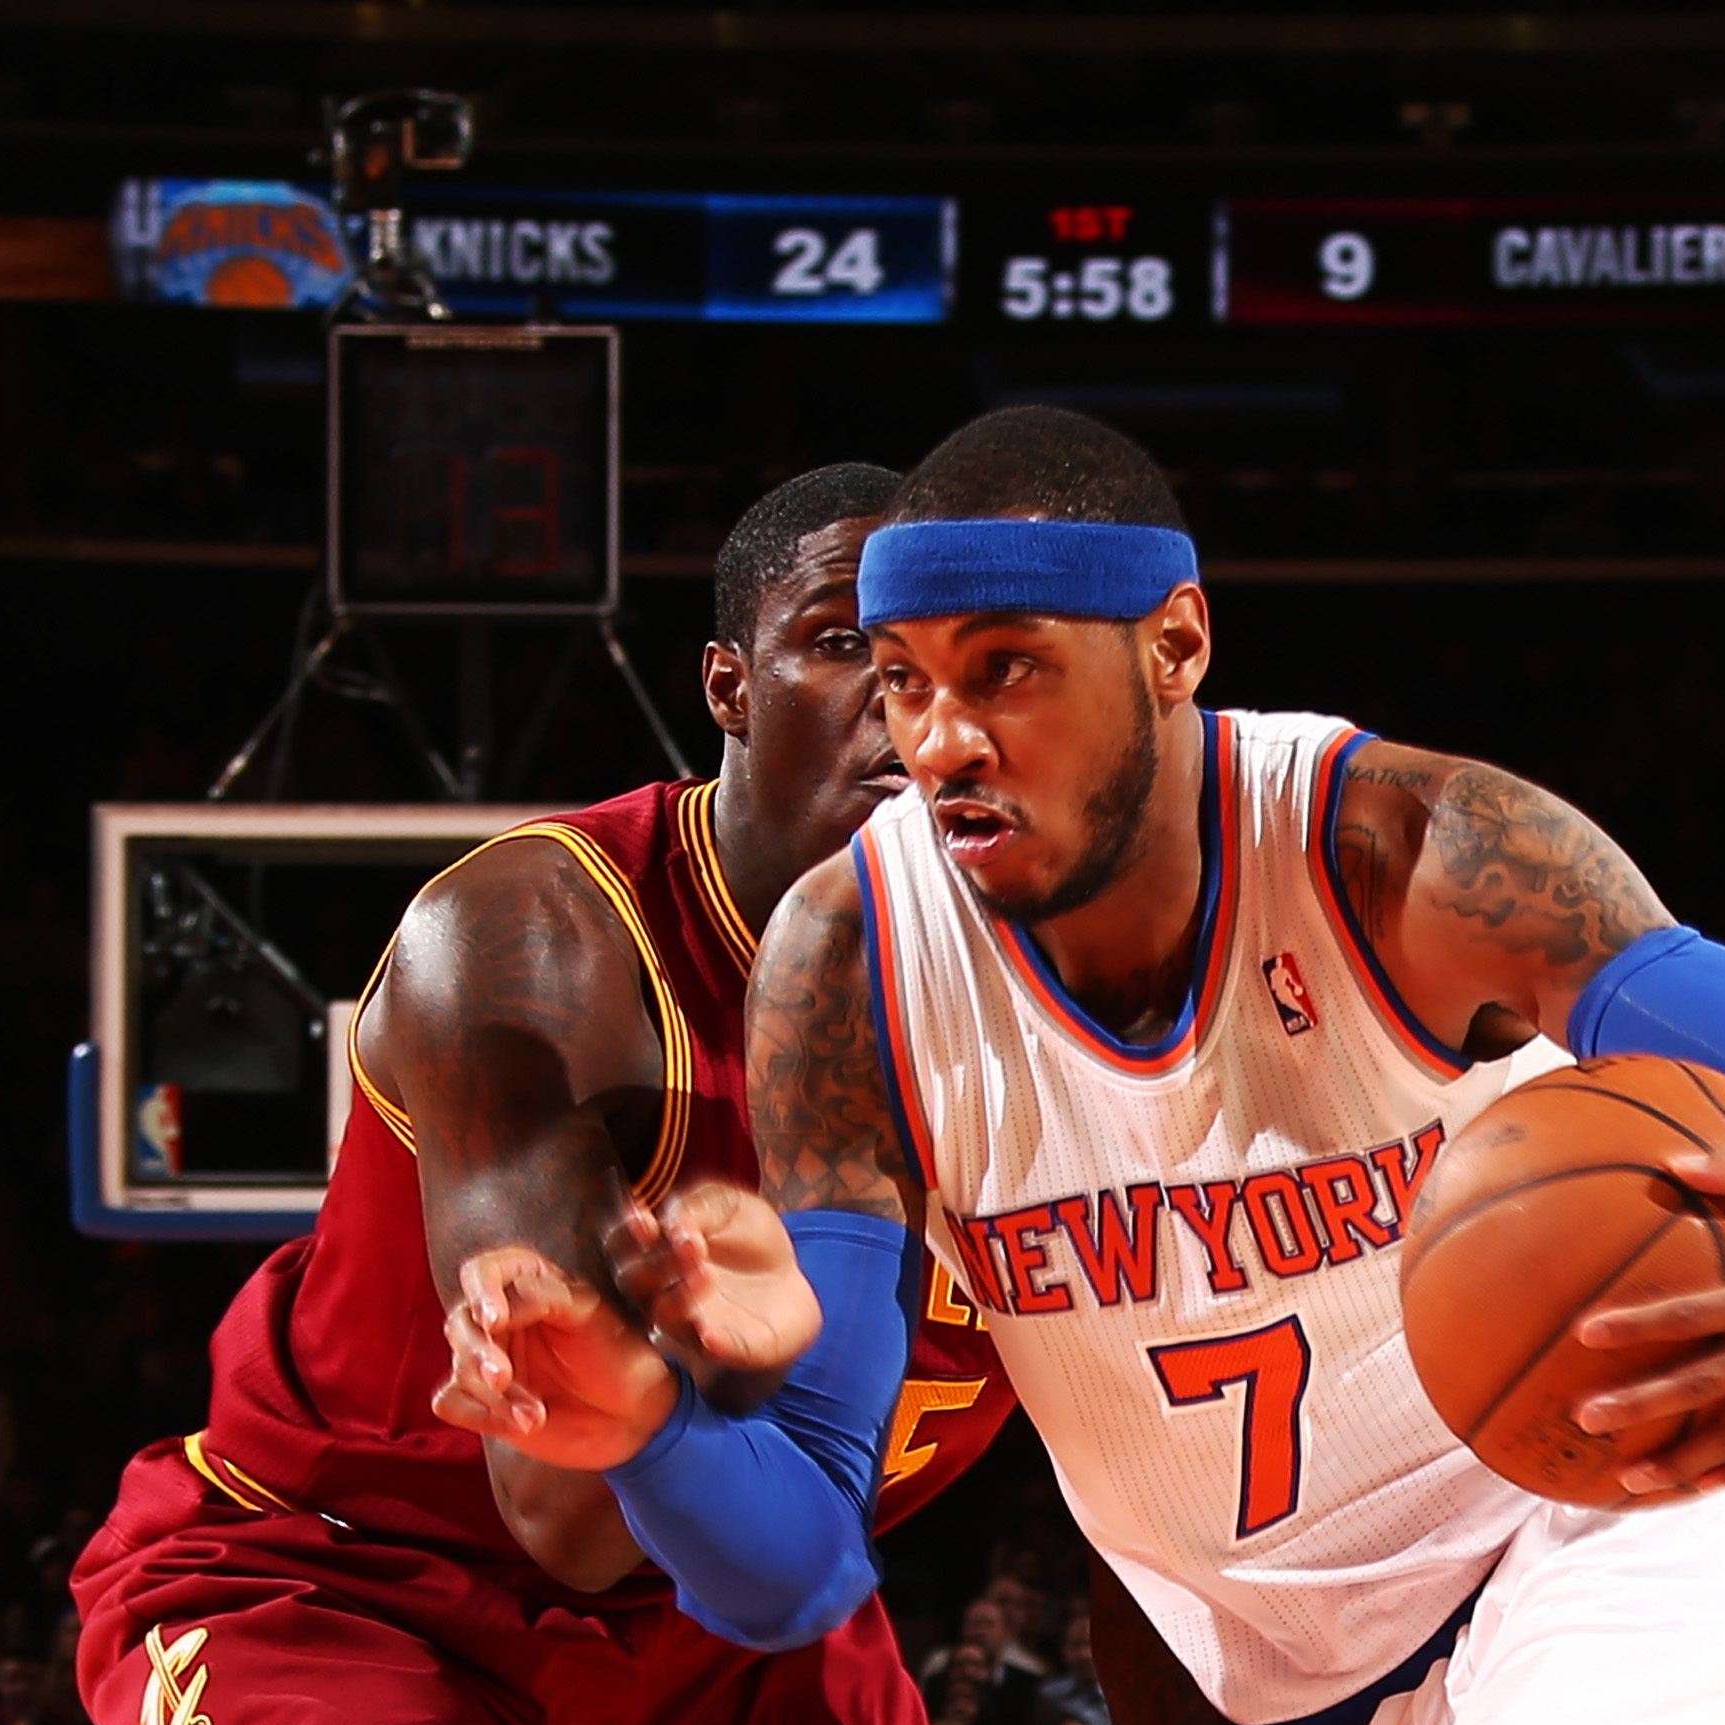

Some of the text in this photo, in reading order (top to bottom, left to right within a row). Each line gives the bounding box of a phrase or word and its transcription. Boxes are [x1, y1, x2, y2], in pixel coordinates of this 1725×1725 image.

[412, 217, 616, 284] KNICKS
[1048, 206, 1135, 242] 1ST
[770, 227, 885, 296] 24
[1002, 256, 1174, 320] 5:58
[1318, 231, 1375, 301] 9
[944, 1180, 1168, 1315] NEW
[1163, 1117, 1445, 1294] YORK
[1147, 1315, 1312, 1540] 7
